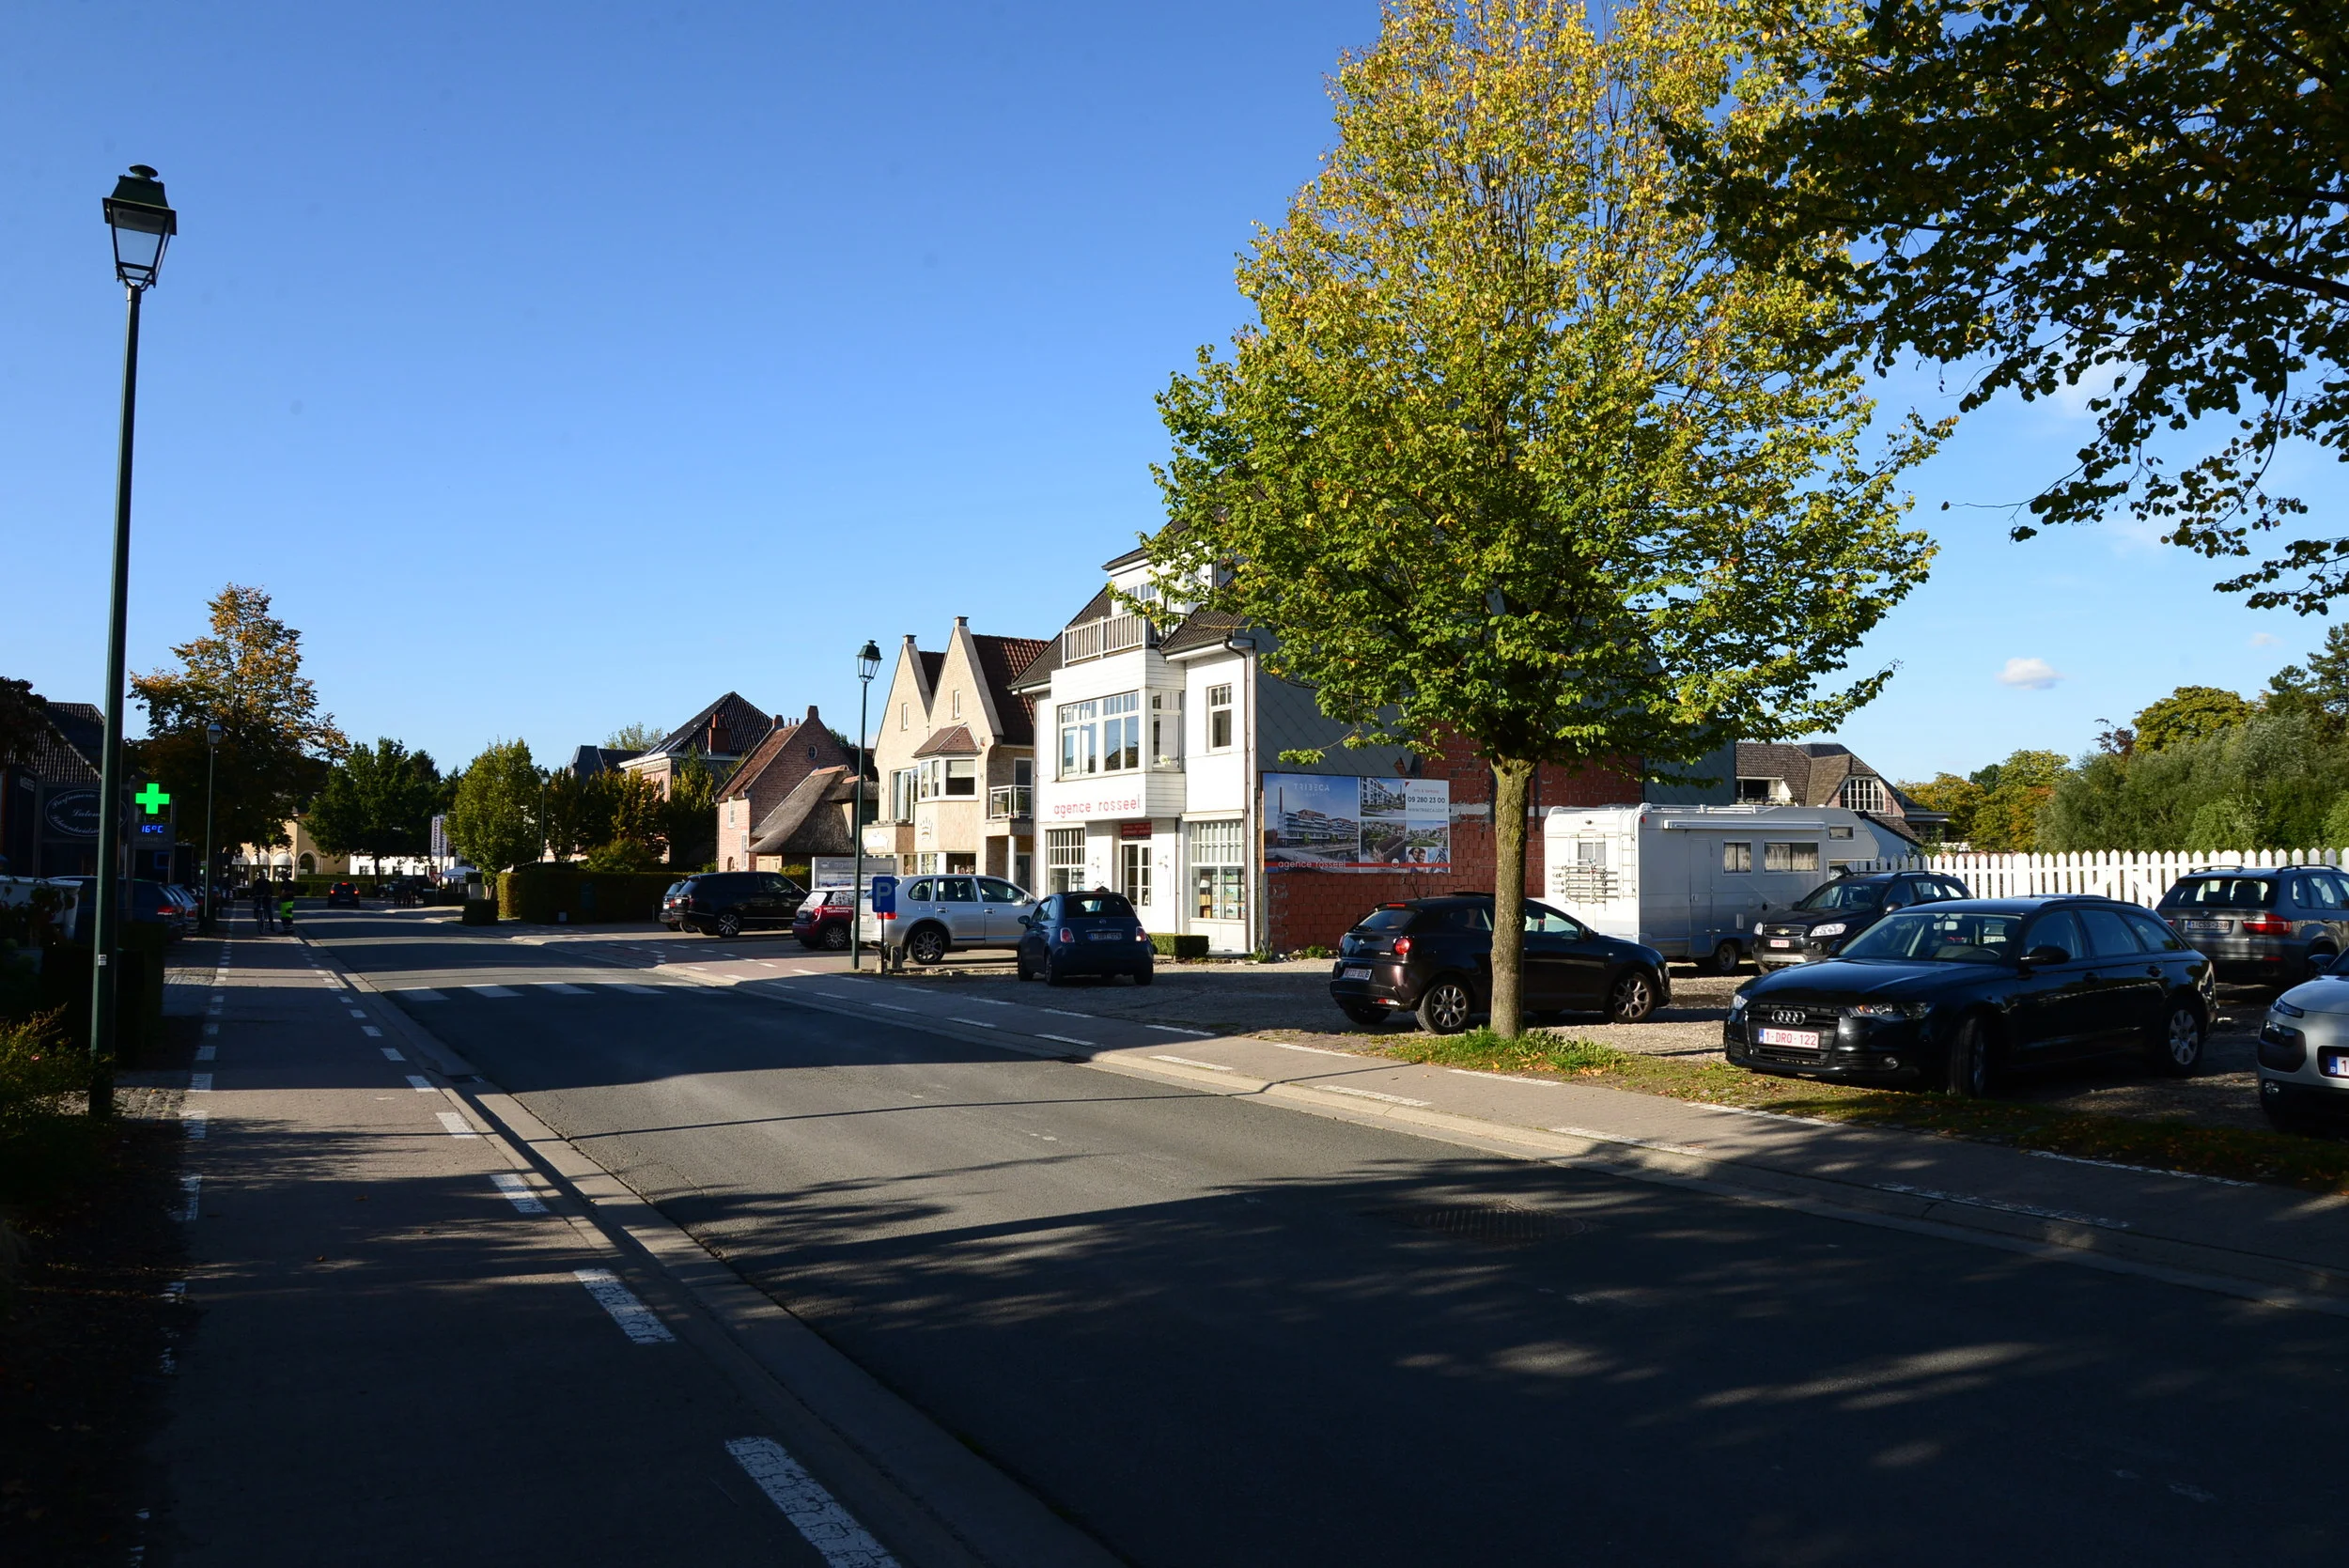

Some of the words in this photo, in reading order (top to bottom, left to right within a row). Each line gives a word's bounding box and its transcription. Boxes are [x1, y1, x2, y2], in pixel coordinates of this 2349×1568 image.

[1293, 783, 1330, 792] TRIBECA
[1053, 802, 1091, 818] agence
[1098, 793, 1141, 812] rosseel
[1278, 861, 1313, 871] agence
[1315, 859, 1346, 869] rosseel
[876, 882, 893, 908] P
[1766, 1032, 1817, 1046] 1-DRO-122
